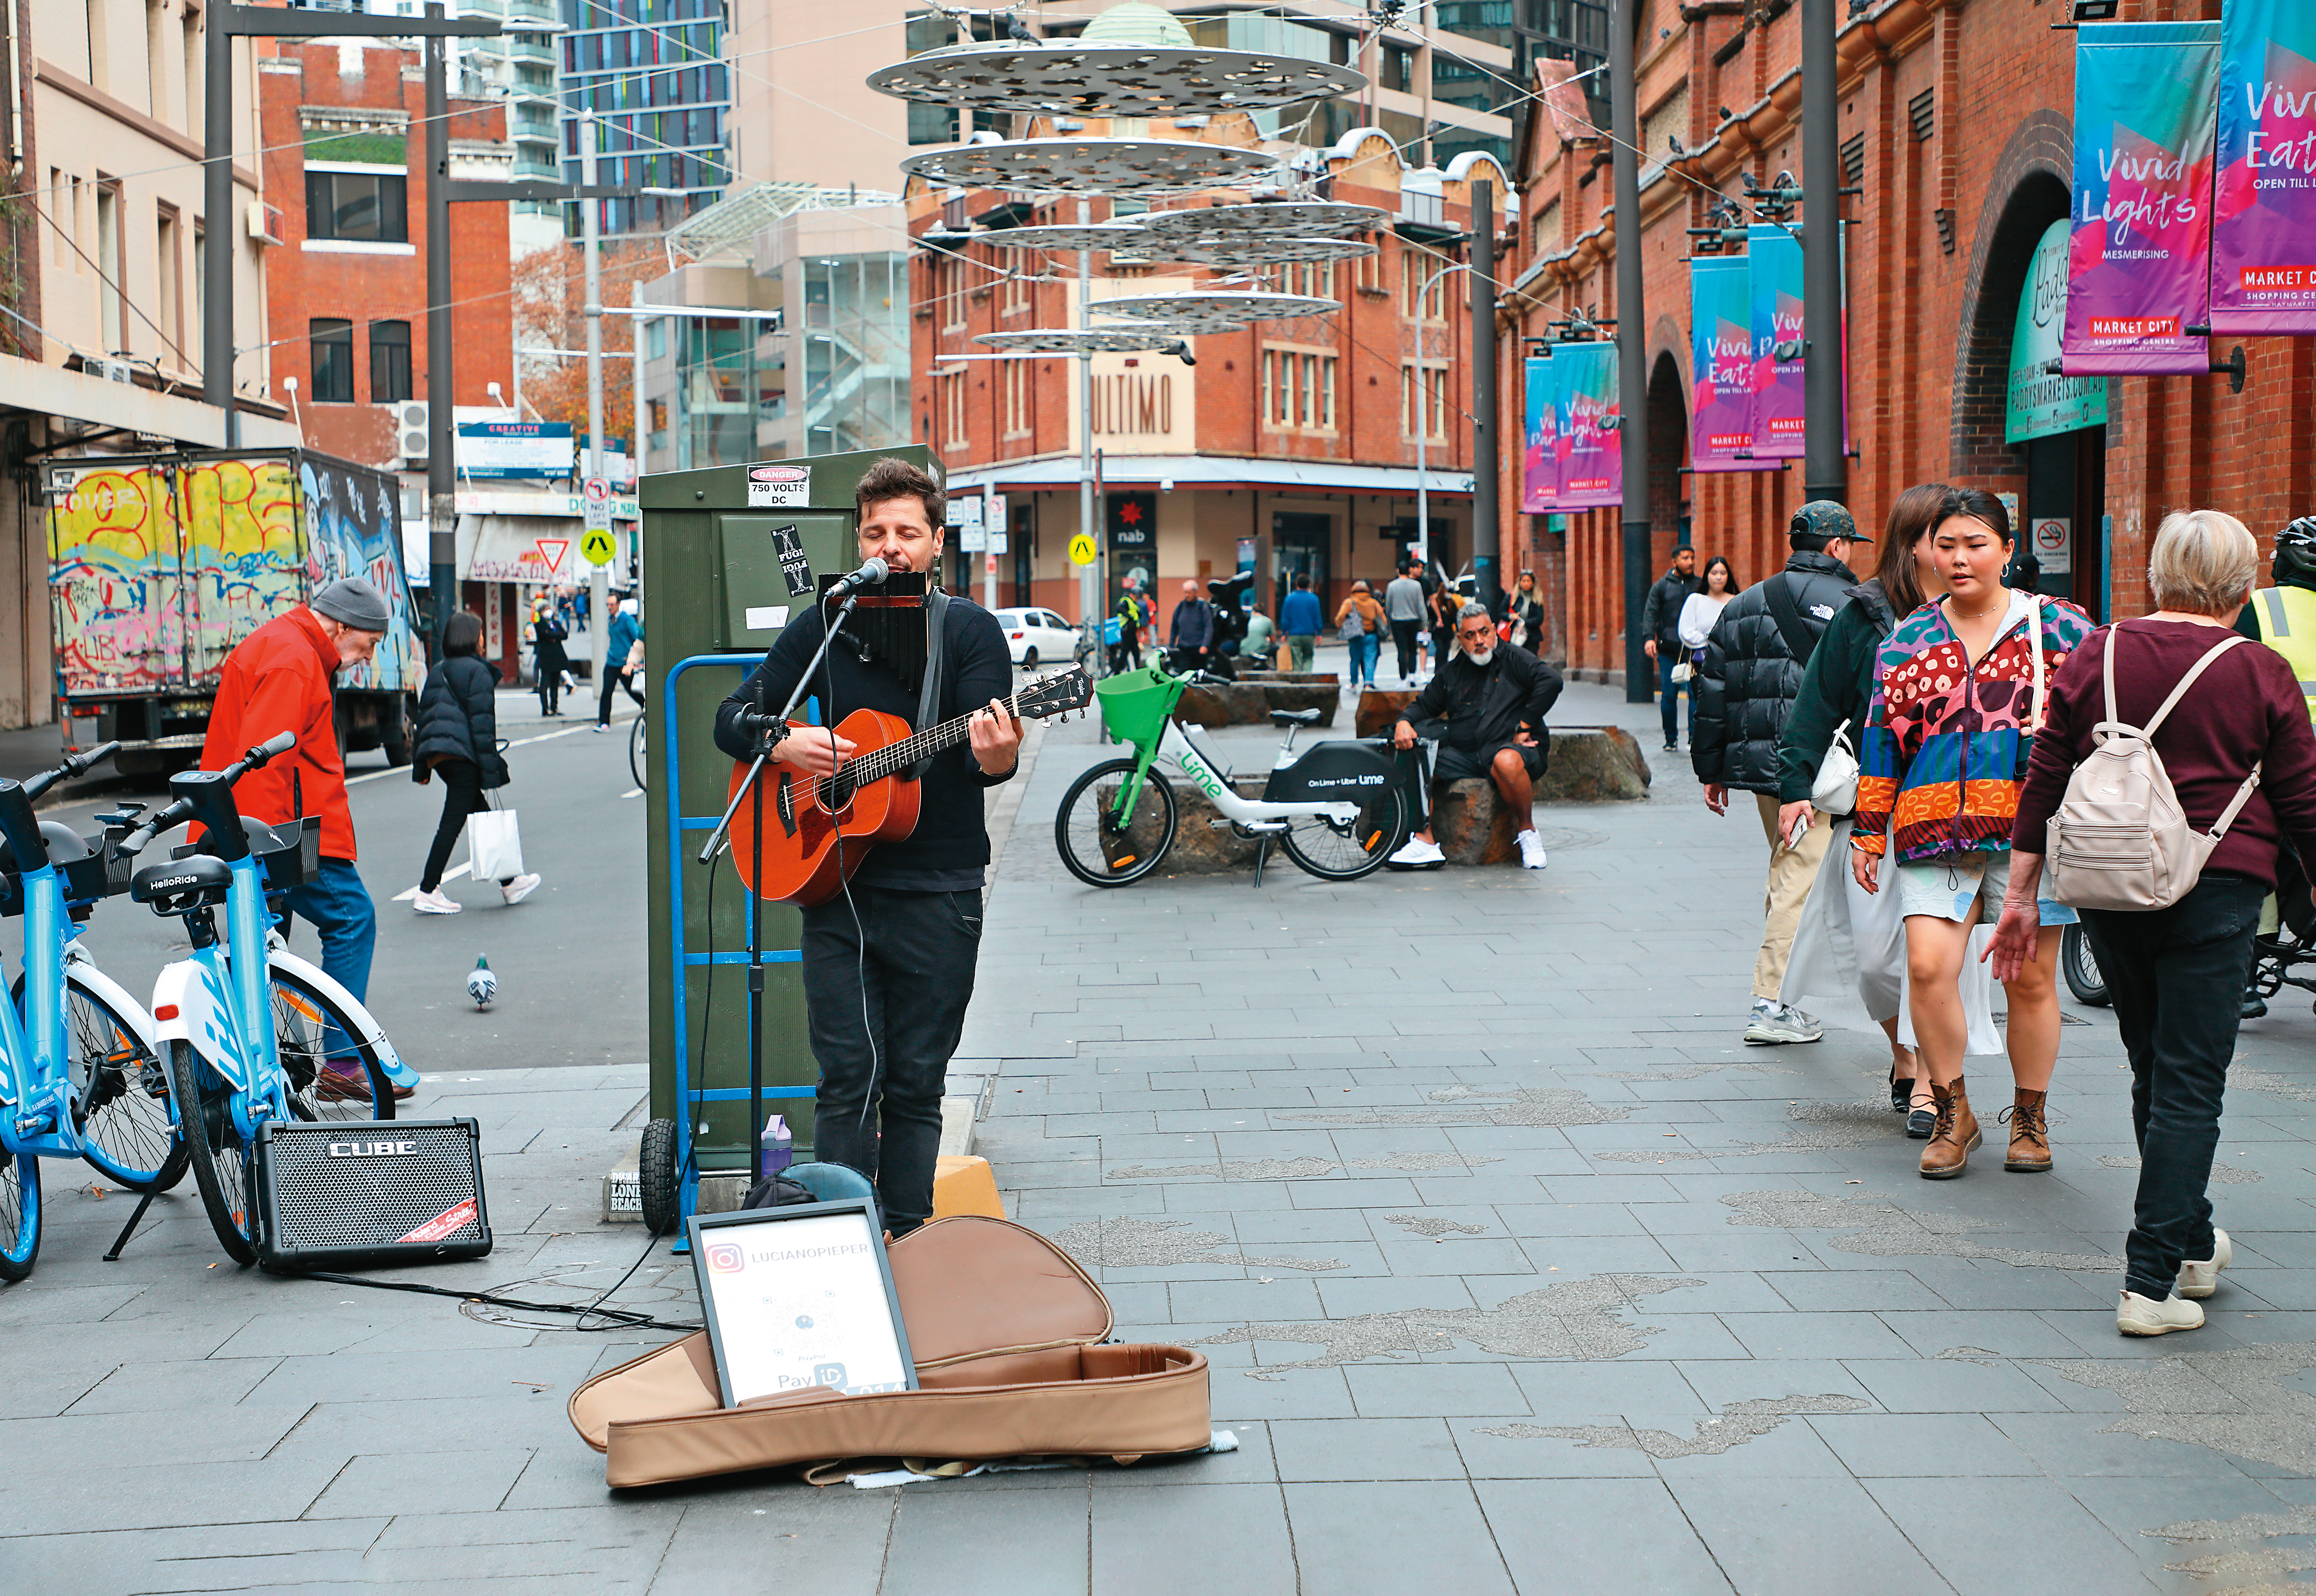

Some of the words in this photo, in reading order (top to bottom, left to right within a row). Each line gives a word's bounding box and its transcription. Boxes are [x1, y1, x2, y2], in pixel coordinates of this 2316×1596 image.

[2099, 139, 2188, 182] Vivid
[2253, 179, 2287, 189] OPEN
[2290, 178, 2309, 188] TILL
[2083, 188, 2196, 245] Lights
[2102, 249, 2169, 259] MESMERISING
[2246, 271, 2302, 285] MARKET
[2094, 321, 2143, 334] MARKET
[2149, 320, 2175, 333] CITY
[1707, 336, 1751, 358] Vivi
[1091, 374, 1171, 434] ULTIMO
[1565, 396, 1608, 417] Vivid
[1772, 421, 1804, 430] MARKET
[1712, 436, 1741, 445] MARKET
[1118, 529, 1145, 543] nab
[779, 548, 804, 562] FUGI
[782, 560, 808, 573] FUGI
[1810, 605, 1826, 614] NORTH
[1813, 610, 1825, 618] FACE
[1077, 677, 1085, 696] Taylor
[1181, 752, 1221, 798] Lime
[1358, 775, 1384, 785] Lime
[150, 875, 197, 890] HelloRide
[59, 928, 68, 1030] HelloRide
[329, 1140, 417, 1157] CUBE
[611, 1197, 643, 1211] BEACH
[425, 1224, 446, 1239] CUBE
[445, 1202, 475, 1228] Street
[410, 1221, 439, 1240] Roland
[752, 1244, 869, 1263] LUCIANOPIEPER
[778, 1375, 812, 1388] Pay
